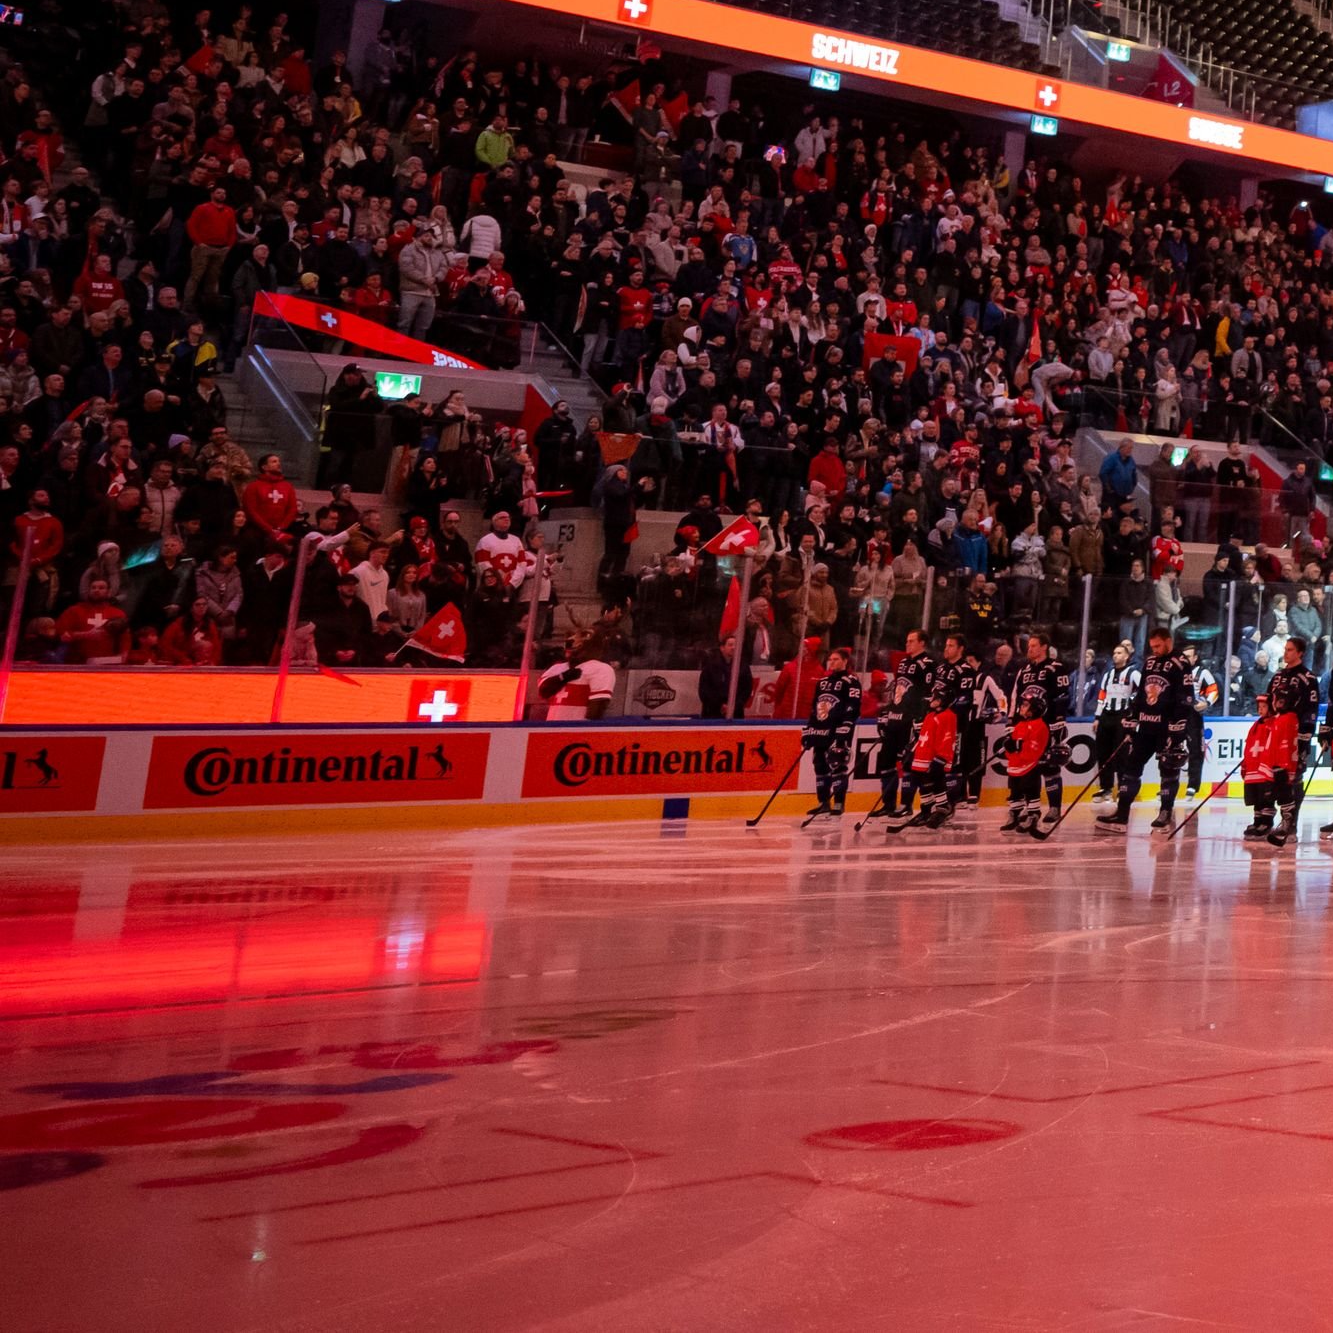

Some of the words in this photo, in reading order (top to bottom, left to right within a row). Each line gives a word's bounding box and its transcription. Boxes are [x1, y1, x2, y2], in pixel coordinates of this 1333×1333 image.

[811, 32, 900, 75] SCHWEIZ
[1163, 81, 1181, 97] L2
[557, 523, 575, 542] F3
[960, 677, 973, 689] 27
[1056, 675, 1068, 687] 50
[184, 746, 419, 796] Continental
[553, 741, 746, 787] Continental
